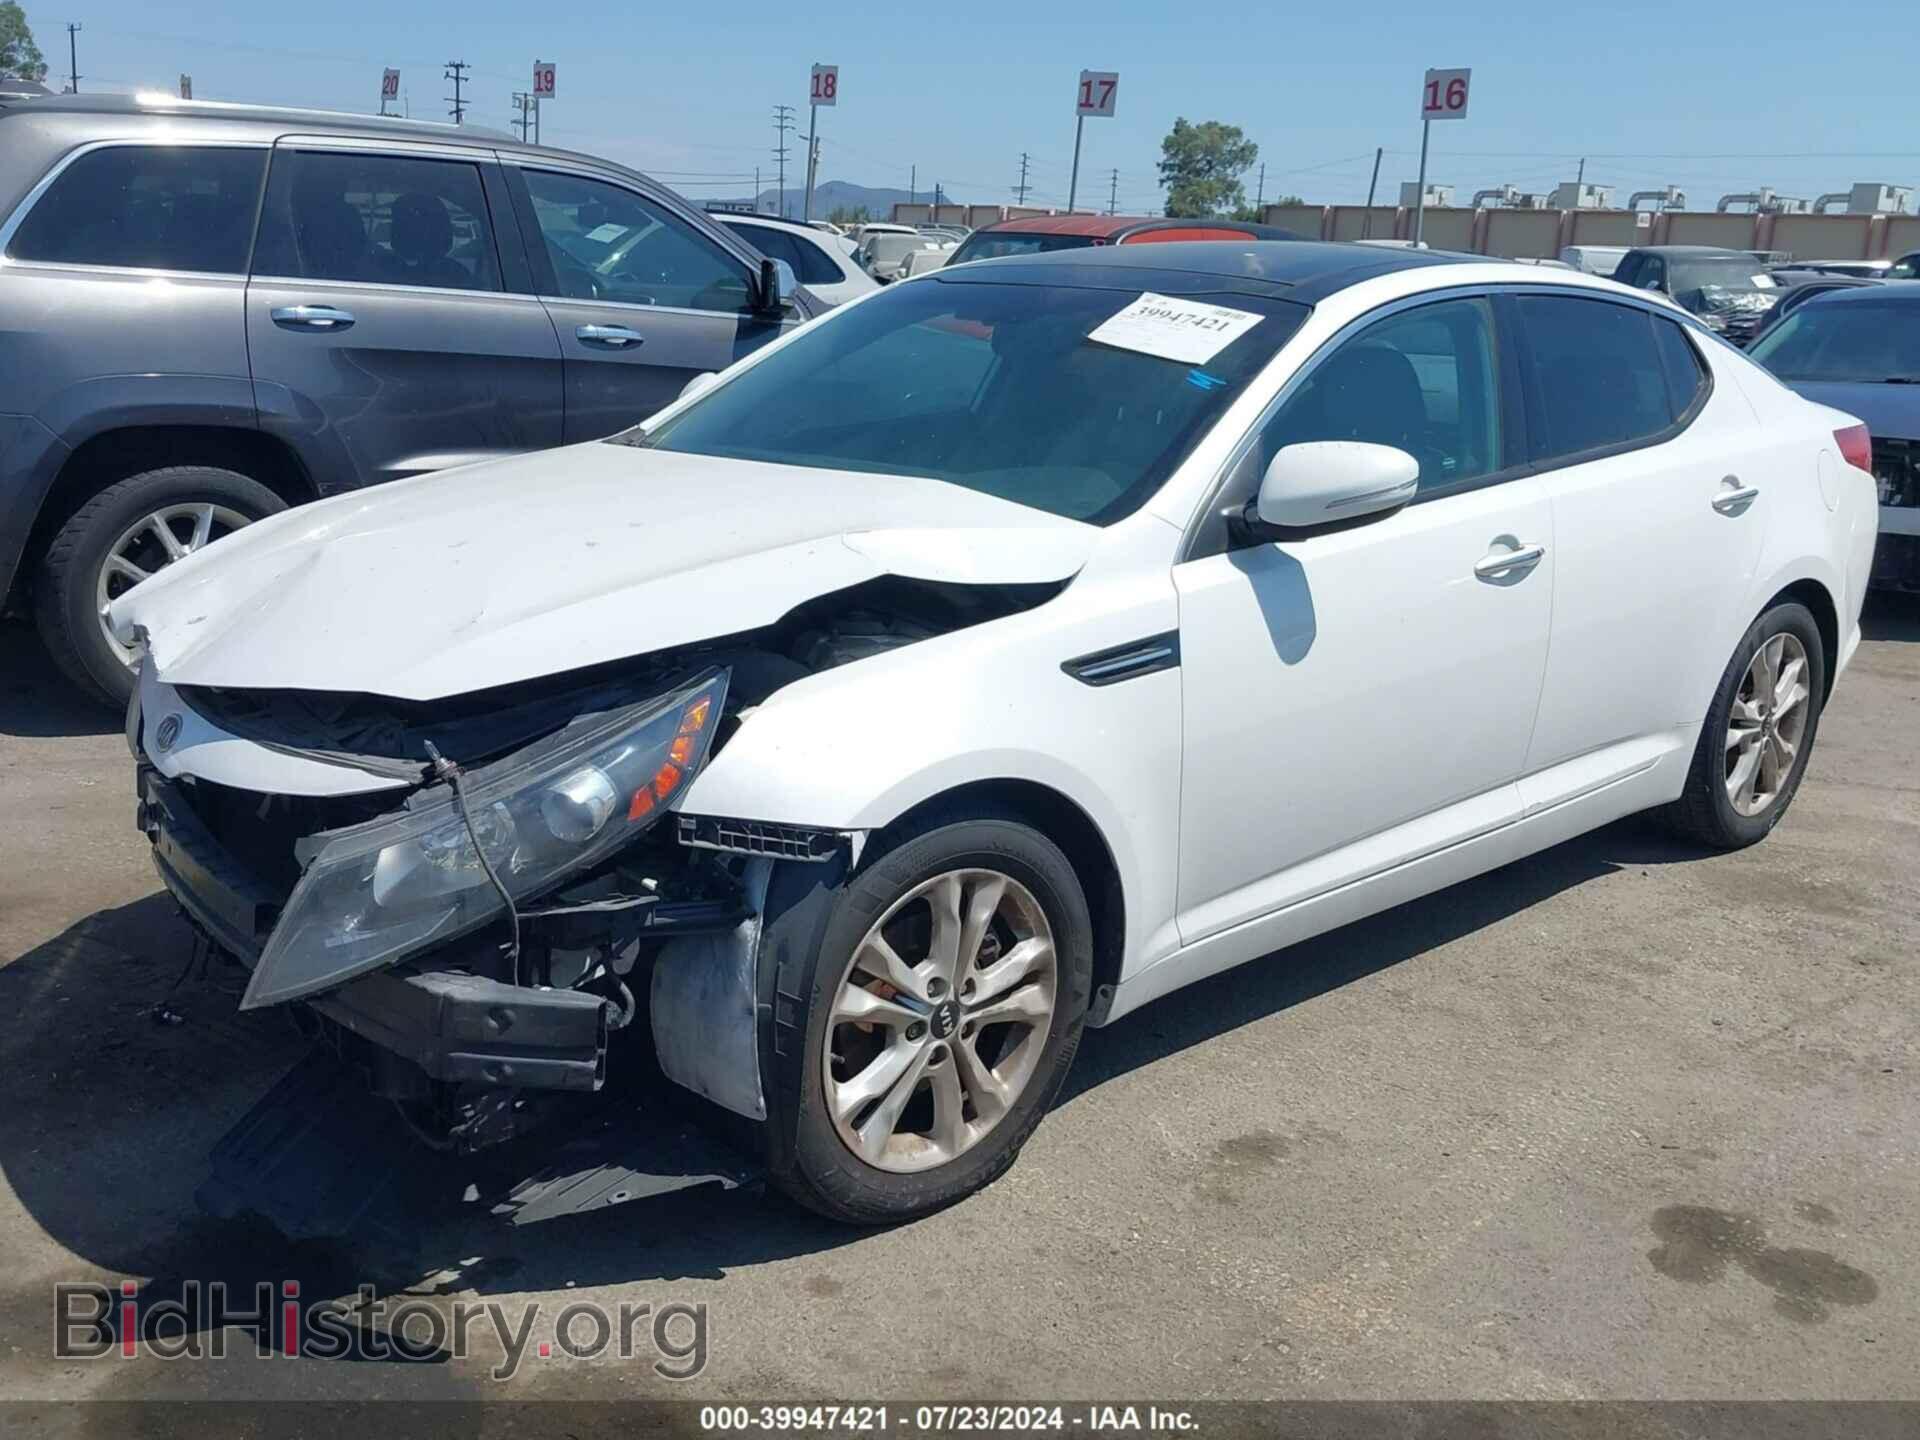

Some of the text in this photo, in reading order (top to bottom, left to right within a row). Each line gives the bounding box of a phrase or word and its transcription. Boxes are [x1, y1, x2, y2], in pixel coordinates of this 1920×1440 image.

[383, 75, 399, 95] 20
[535, 70, 554, 92] 19
[811, 73, 836, 98] 18
[1079, 79, 1116, 109] 17
[1425, 78, 1466, 110] 16
[1132, 306, 1230, 332] 39947421
